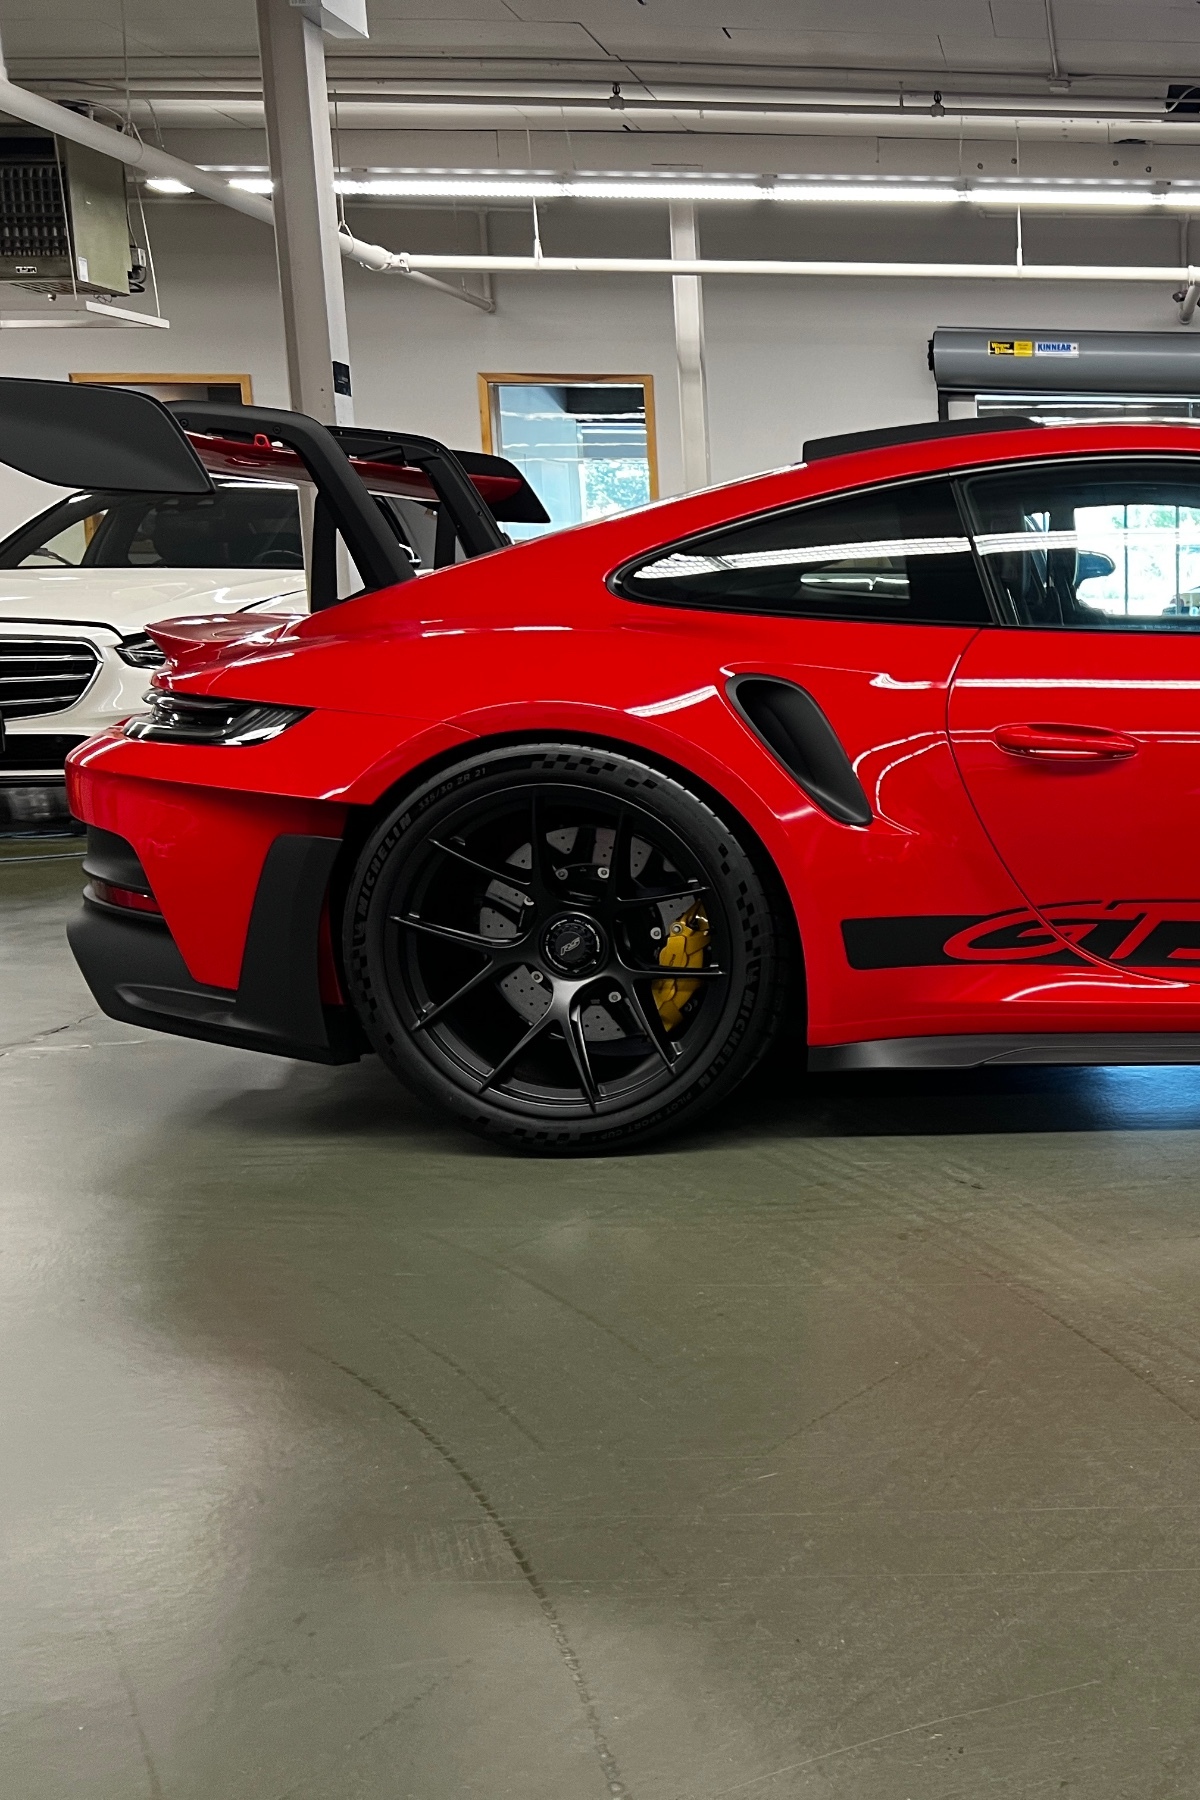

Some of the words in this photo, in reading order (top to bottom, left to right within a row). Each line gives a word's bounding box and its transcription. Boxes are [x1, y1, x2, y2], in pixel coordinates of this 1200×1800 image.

[1037, 343, 1072, 352] KINNEAR
[357, 812, 412, 917] MICHELIN
[418, 782, 454, 811] 335/30
[457, 772, 471, 786] ZR
[475, 767, 486, 778] 21
[560, 936, 581, 956] RS
[698, 989, 756, 1089] MICHELIN
